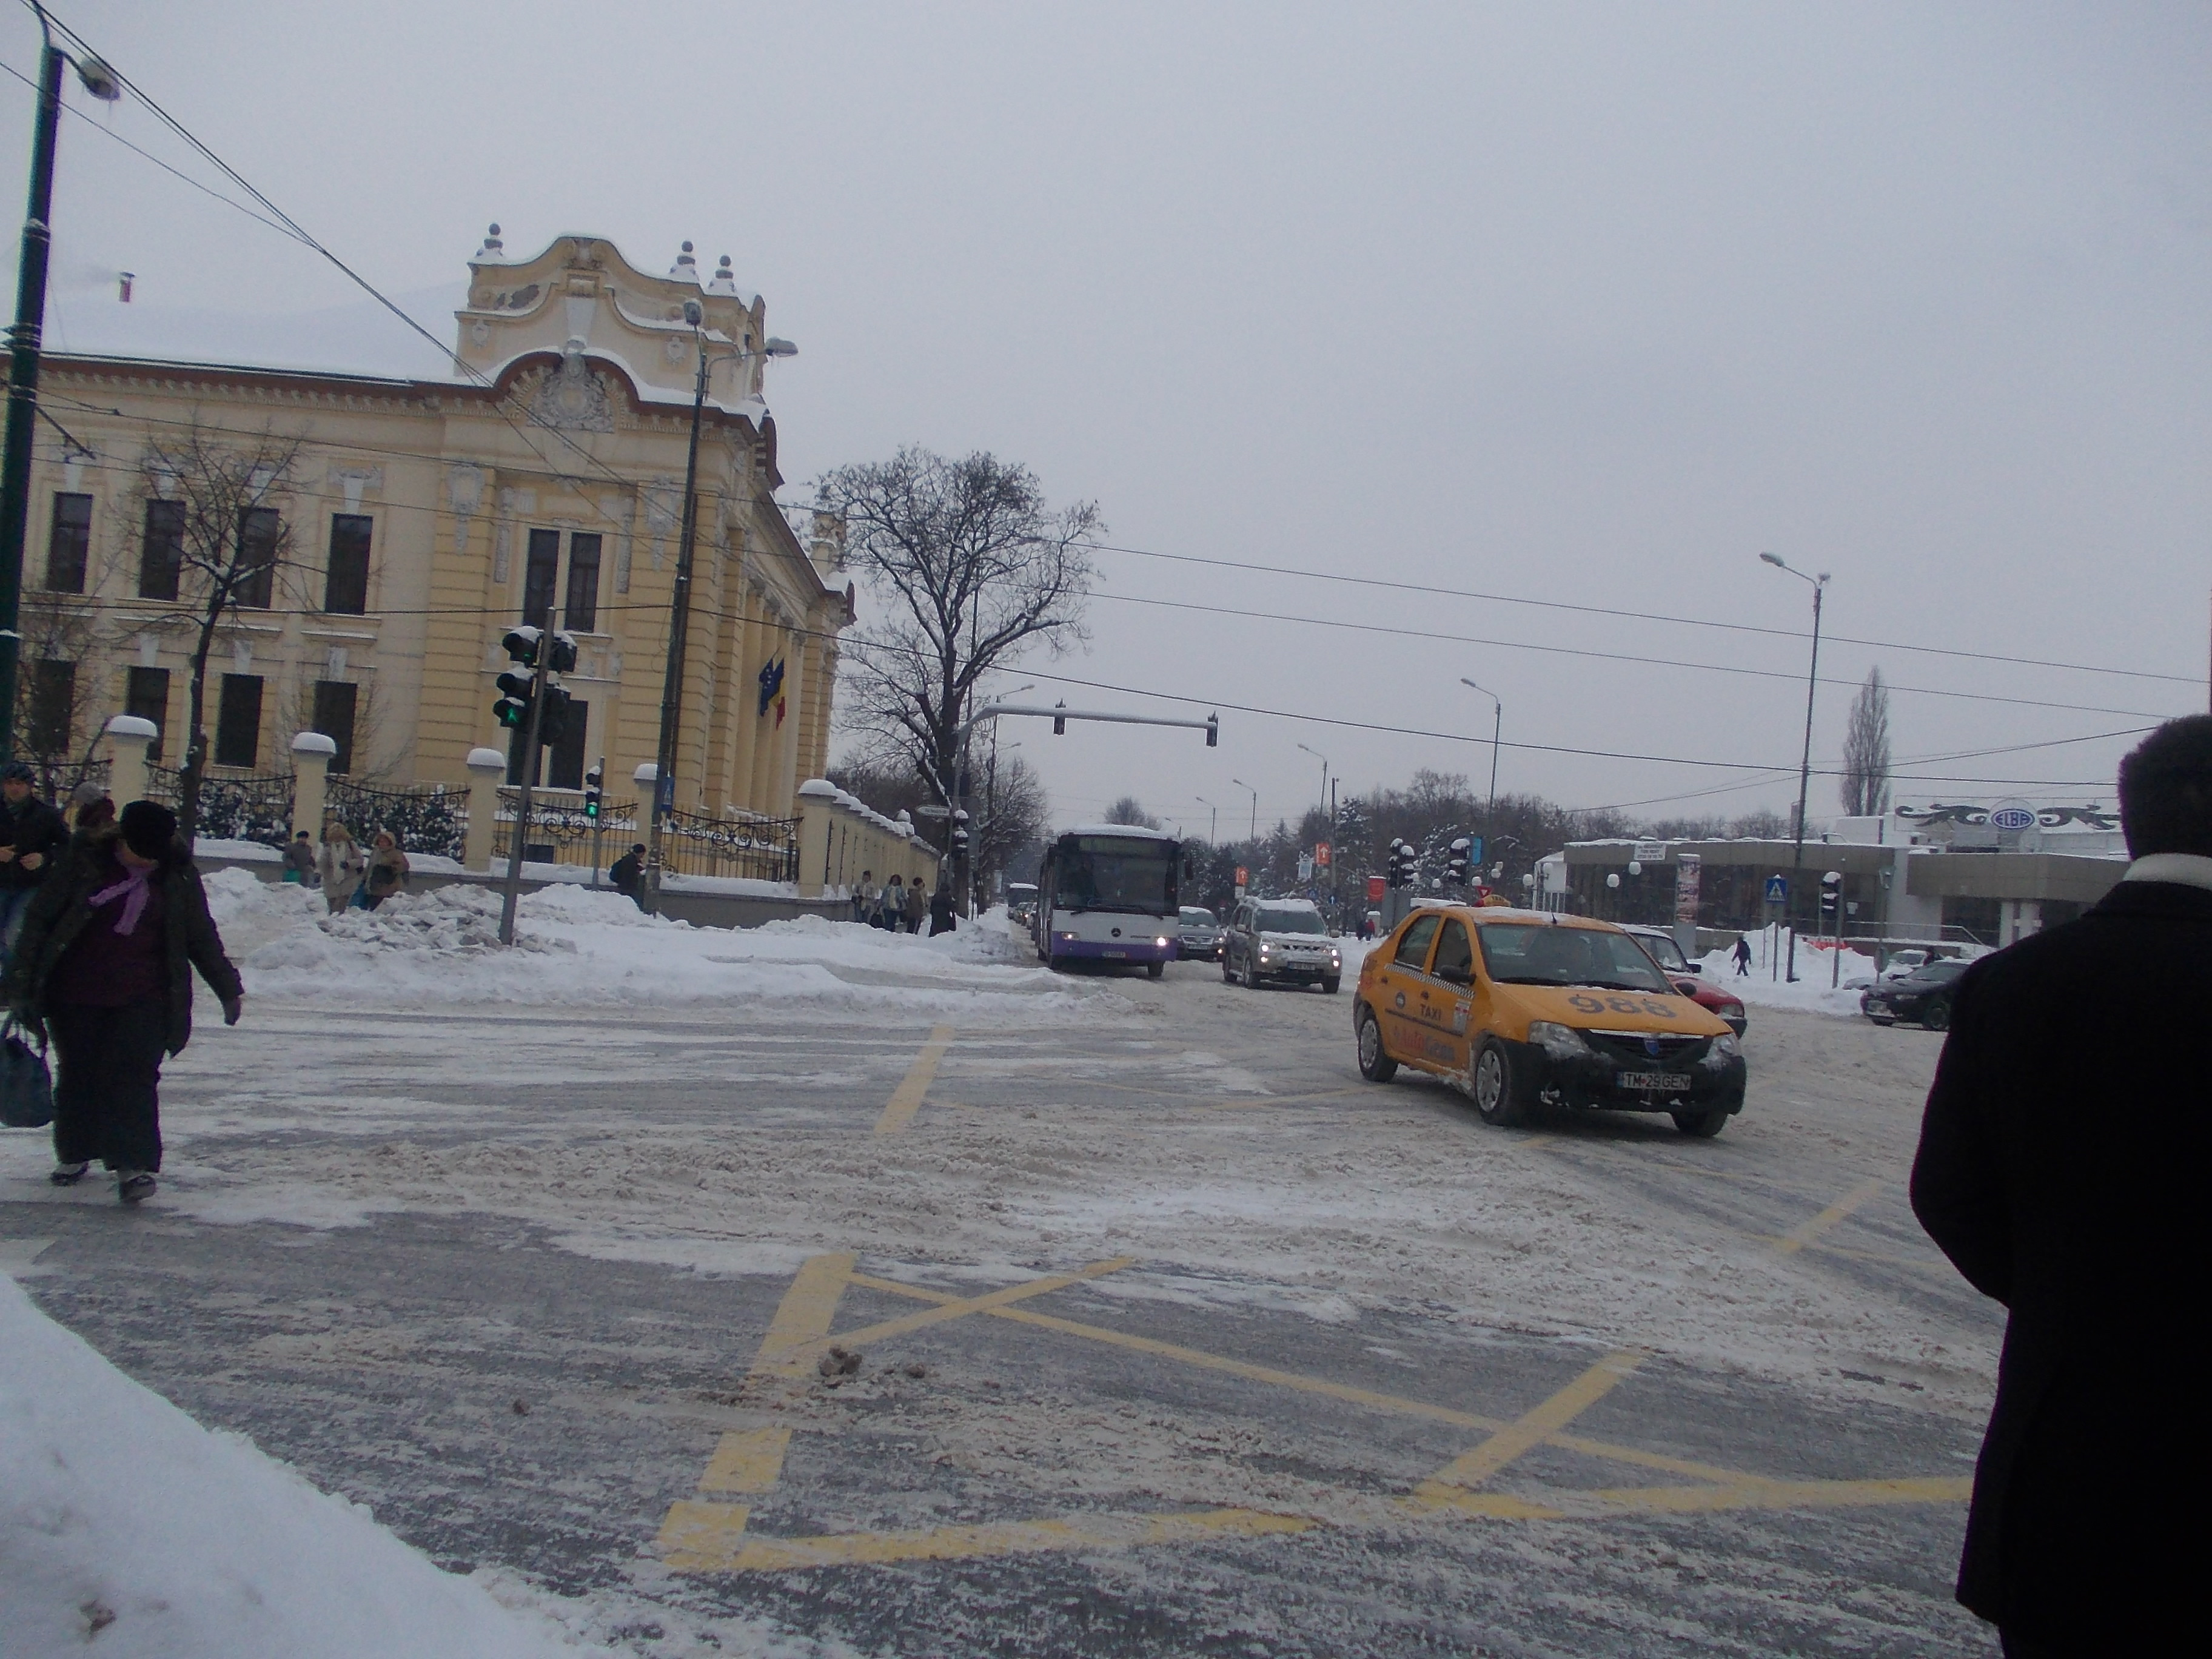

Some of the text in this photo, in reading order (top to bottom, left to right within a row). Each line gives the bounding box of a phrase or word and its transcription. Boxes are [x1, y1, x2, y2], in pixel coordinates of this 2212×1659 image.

[1995, 812, 2031, 826] ELBA
[1420, 1004, 1441, 1021] TAXI
[1569, 996, 1677, 1018] 988
